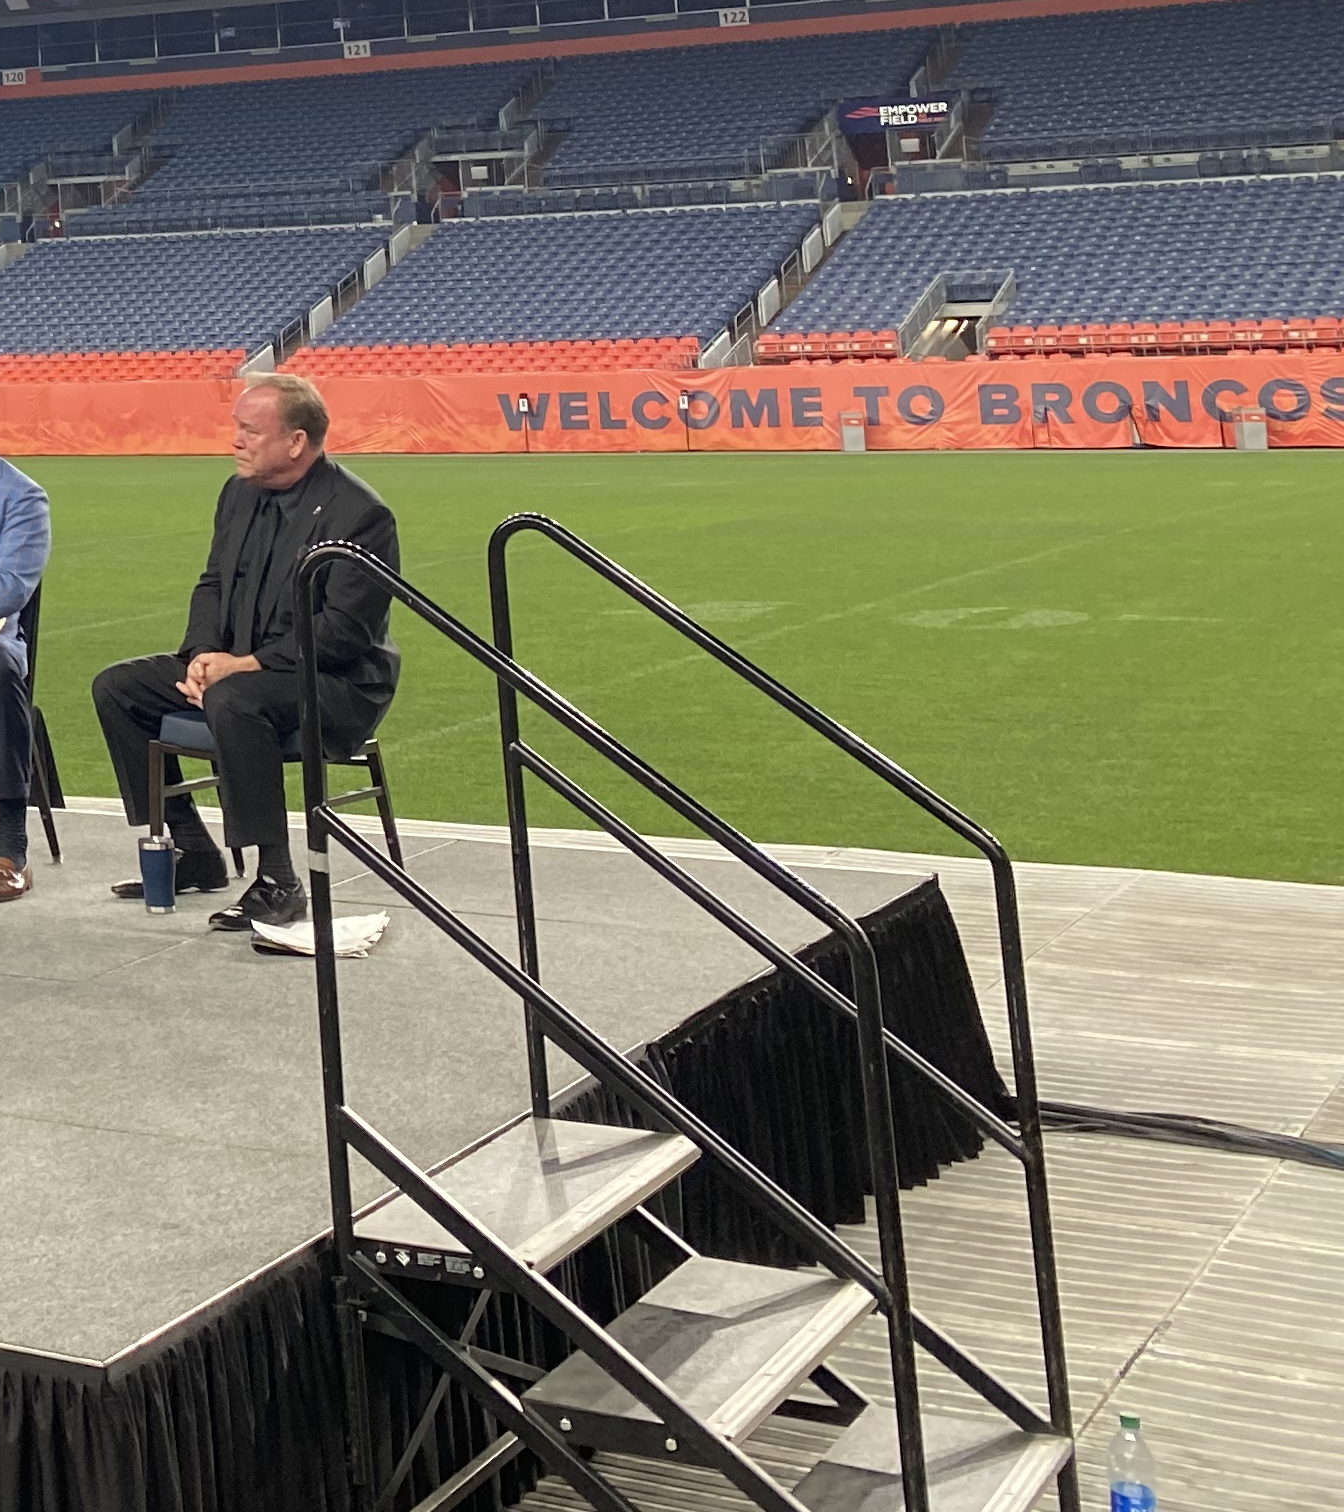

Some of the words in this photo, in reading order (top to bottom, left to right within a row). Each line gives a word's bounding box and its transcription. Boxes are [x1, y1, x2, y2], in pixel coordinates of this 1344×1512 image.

[722, 10, 747, 24] 122
[346, 43, 369, 56] 121
[4, 71, 25, 83] 120
[878, 101, 948, 117] EMPOWER
[879, 114, 918, 126] FIELD
[496, 388, 824, 431] WELCOME
[853, 384, 945, 427] TO
[977, 376, 1344, 424] BRONCOS
